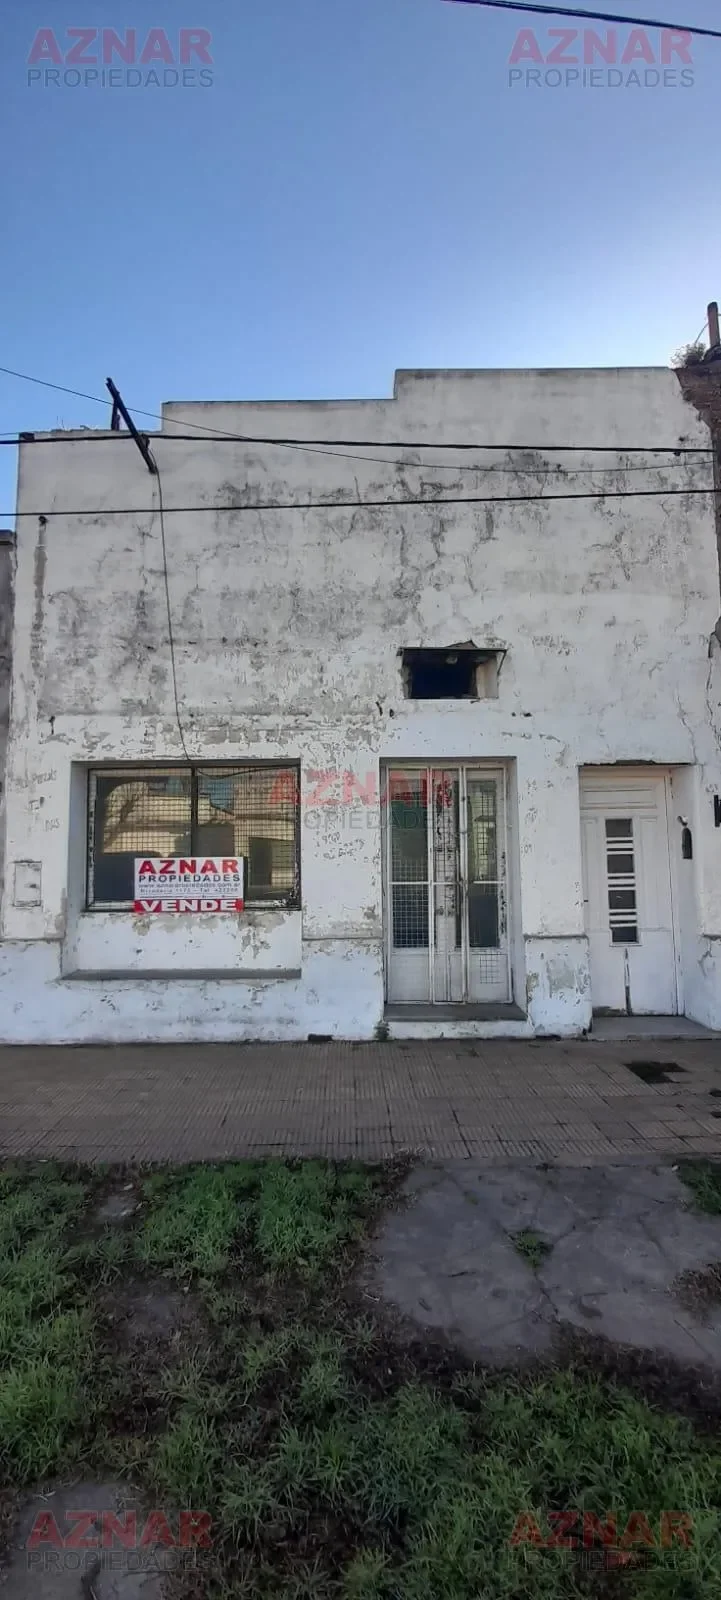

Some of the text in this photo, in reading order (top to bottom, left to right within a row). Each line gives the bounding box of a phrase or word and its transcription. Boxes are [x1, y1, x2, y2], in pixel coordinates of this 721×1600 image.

[138, 859, 239, 874] AZNAR
[138, 874, 240, 883] PROPIEDADES
[140, 899, 237, 912] VENDE
